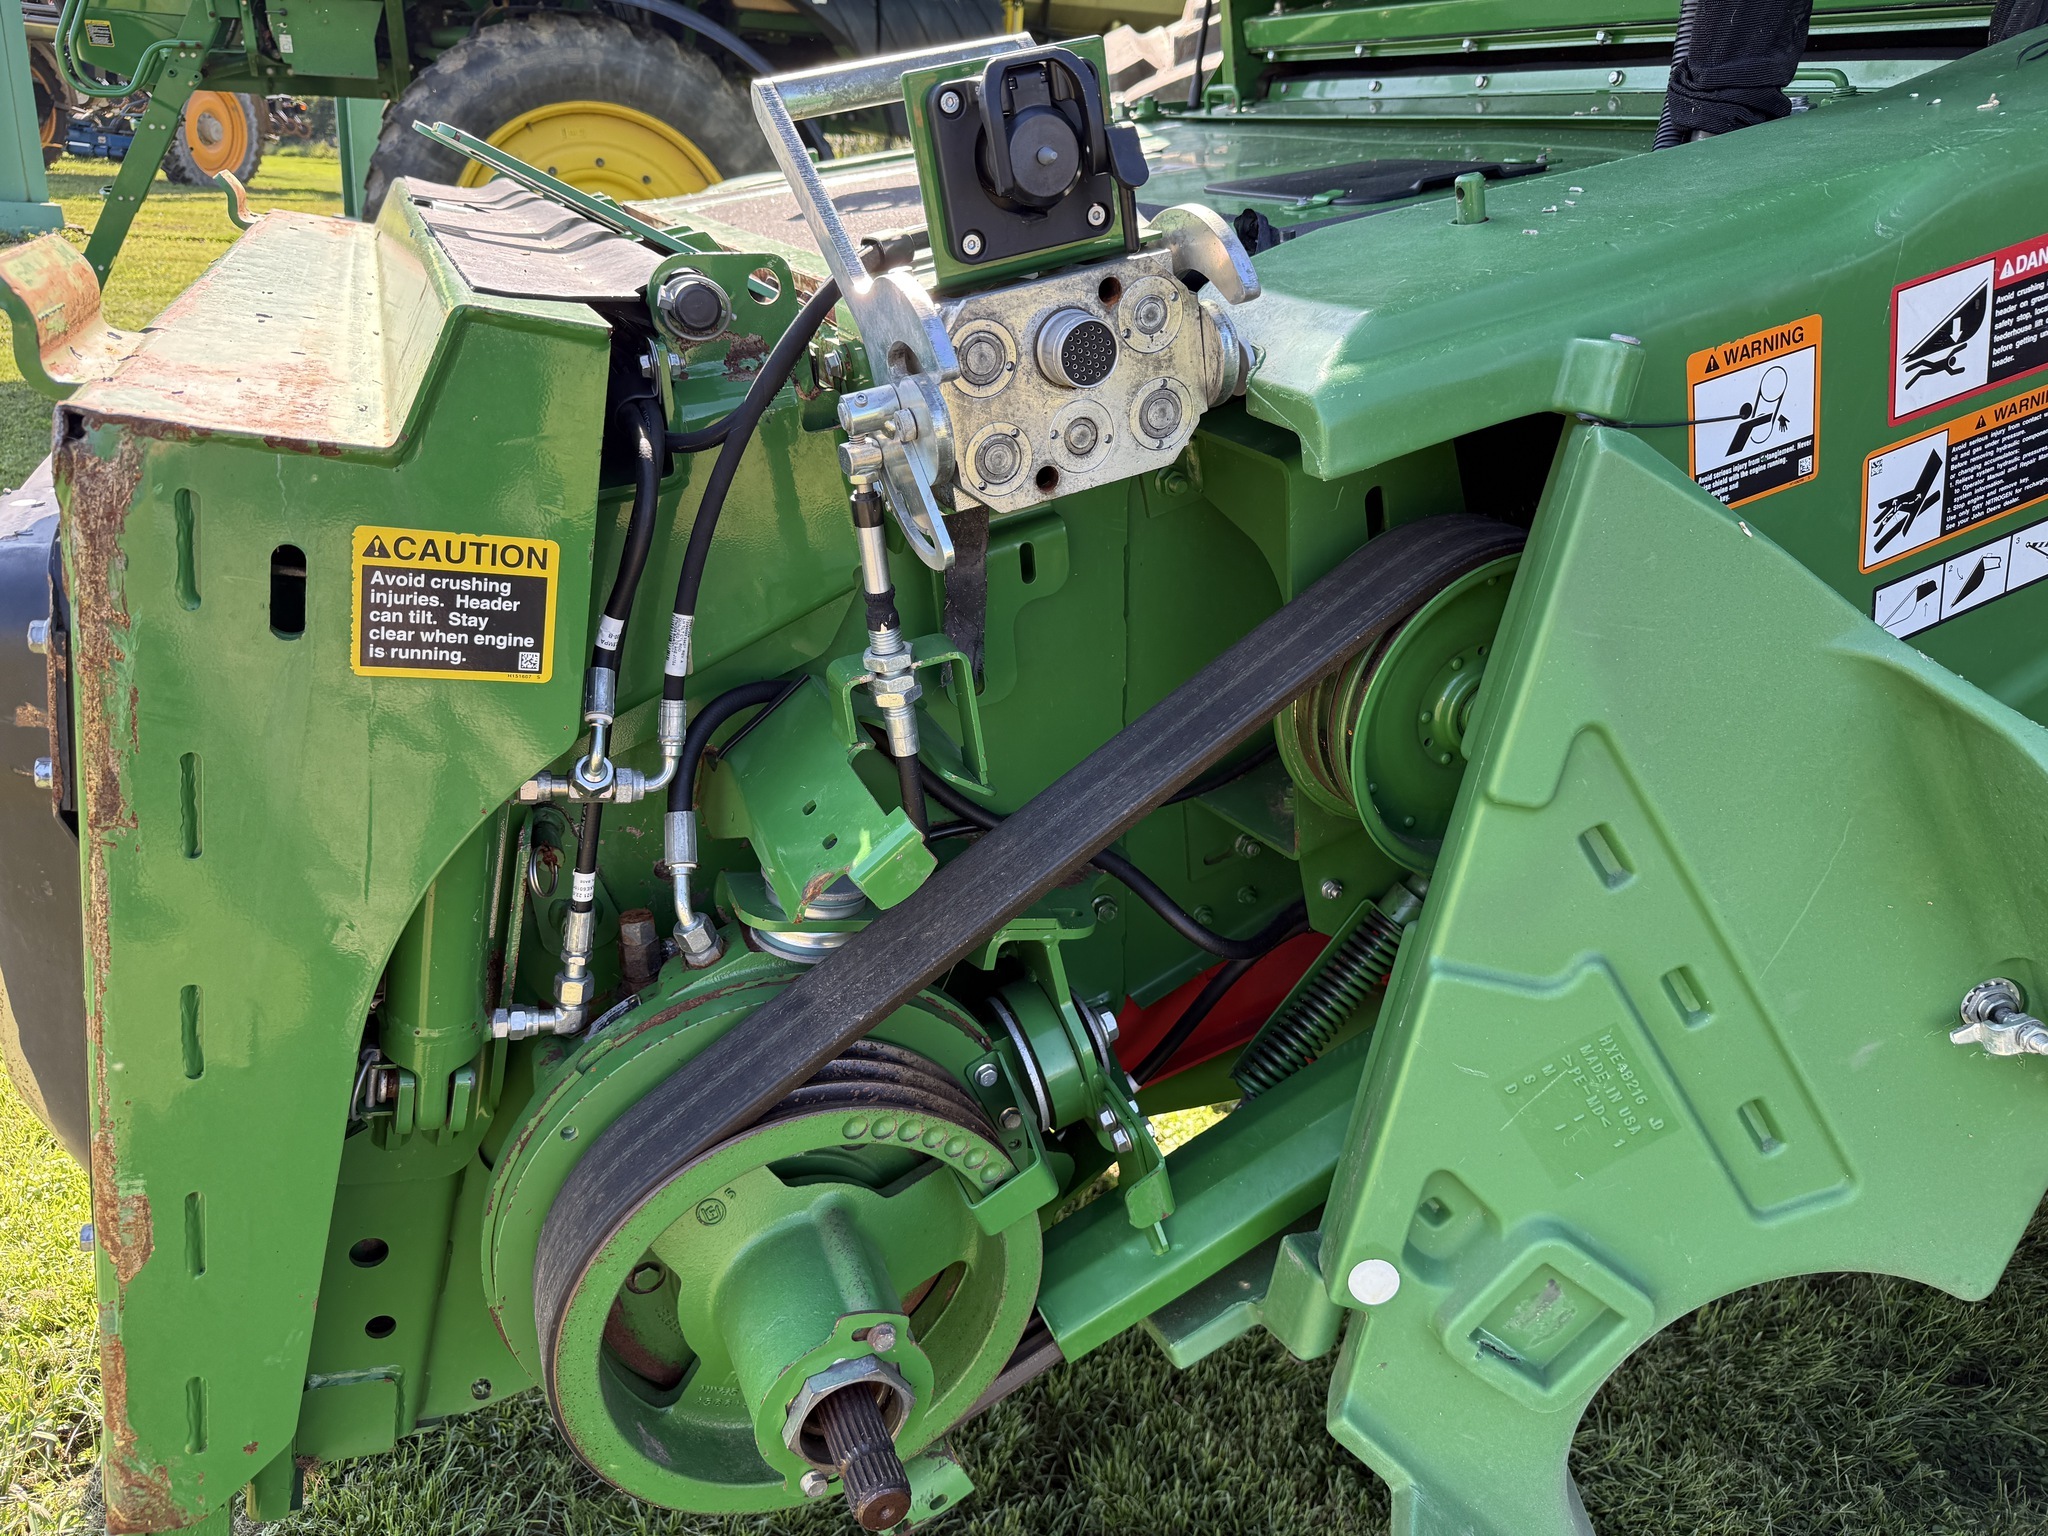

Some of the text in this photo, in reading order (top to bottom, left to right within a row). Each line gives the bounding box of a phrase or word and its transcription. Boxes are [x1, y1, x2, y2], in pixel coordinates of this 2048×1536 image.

[1996, 291, 2014, 304] Avoid
[2017, 282, 2044, 296] crushing
[1995, 304, 2017, 317] header
[1995, 318, 2014, 330] safety
[2016, 312, 2032, 322] stop,
[1994, 324, 2032, 342] feederhouse
[2035, 319, 2043, 327] lift
[1724, 326, 1804, 366] WARNING
[1993, 343, 2013, 355] before
[2016, 334, 2037, 348] getting
[1992, 355, 2014, 368] header.
[1994, 390, 2048, 422] WARNI
[1952, 442, 1967, 453] Avoid
[1969, 435, 1988, 446] serious
[1991, 428, 2006, 438] injury
[2008, 423, 2020, 431] from
[2022, 414, 2042, 425] contact
[1960, 450, 1970, 458] and
[1972, 446, 1982, 455] gas
[1985, 439, 2000, 448] under
[2002, 430, 2026, 443] pressure.
[1713, 468, 1732, 479] serious
[1733, 462, 1747, 472] injury
[1748, 458, 1759, 466] from
[1797, 440, 1811, 449] Never
[1951, 460, 1968, 471] Before
[1970, 450, 1994, 463] removing
[1996, 440, 2020, 453] hydraulic
[1712, 477, 1728, 488] shield
[1729, 473, 1739, 482] with
[1740, 470, 1748, 478] the
[1750, 464, 1766, 475] engine
[1767, 457, 1788, 468] running.
[1955, 475, 1974, 486] Relieve
[1976, 467, 1994, 477] system
[1997, 456, 2020, 469] hydraulic
[1958, 463, 1982, 476] changing
[1962, 478, 1985, 490] Operator
[1987, 469, 2005, 480] Manual
[2007, 464, 2017, 473] and
[2020, 458, 2036, 468] Repair
[1729, 481, 1738, 490] and
[1954, 479, 2004, 502] system information.
[1967, 495, 1984, 505] engine
[1987, 488, 1996, 497] and
[1999, 482, 2017, 492] remove
[1972, 502, 1983, 511] DRY
[1985, 491, 2013, 506] NITROGEN
[1958, 517, 1969, 527] your
[1971, 511, 1984, 520] John
[1987, 504, 2001, 513] Deere
[394, 536, 547, 570] CAUTION
[371, 570, 511, 596] Avoid crushing
[370, 589, 520, 611] injuries. Header
[370, 610, 488, 630] can tilt. Stay
[369, 626, 534, 649] clear when engine
[369, 644, 466, 664] is running.
[1524, 1074, 1536, 1084] S
[1541, 1064, 1556, 1077] M
[1504, 1082, 1518, 1094] D
[1580, 1044, 1642, 1135] MADE IN USA
